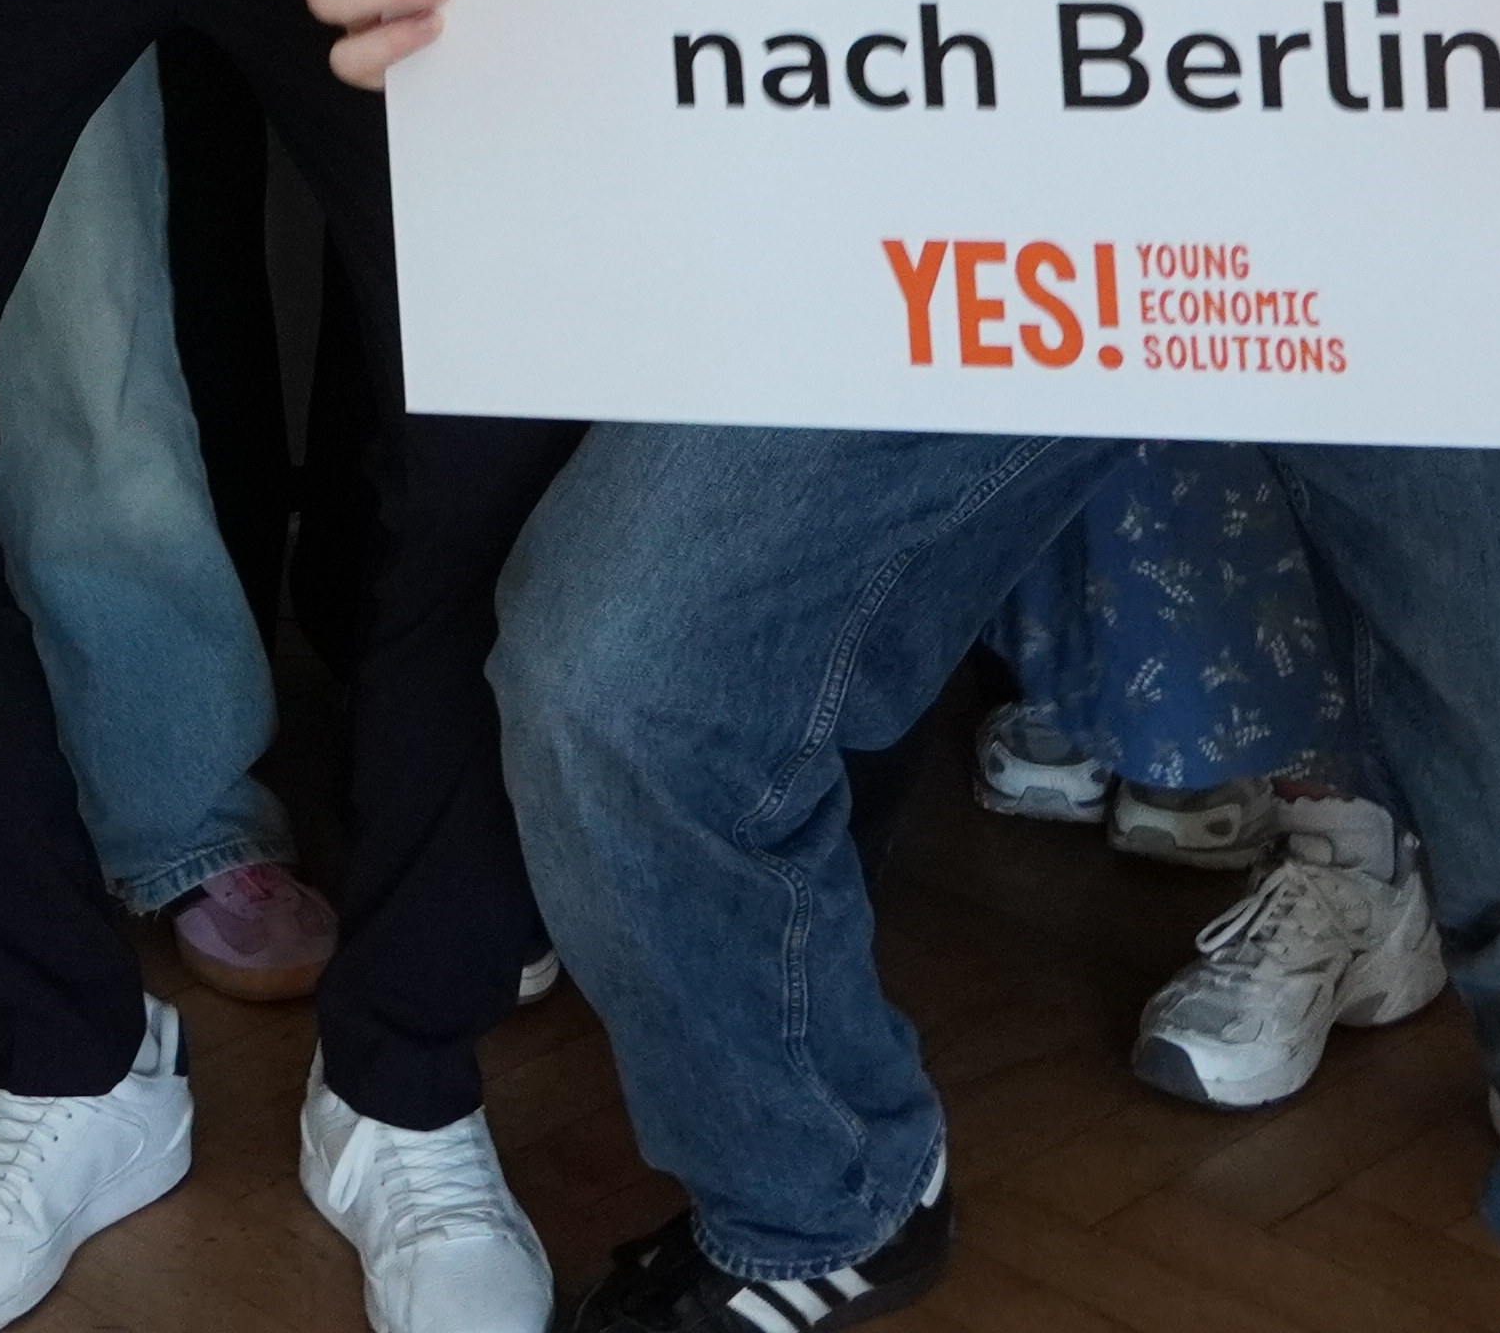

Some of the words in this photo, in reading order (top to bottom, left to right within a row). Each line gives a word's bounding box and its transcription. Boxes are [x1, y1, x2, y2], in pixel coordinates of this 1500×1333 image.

[672, 2, 998, 111] nach
[1136, 242, 1251, 280] YOUNG
[881, 239, 1124, 370] YES!
[1140, 289, 1320, 327] ECONOMIC
[1143, 335, 1348, 373] SOLUTIONS
